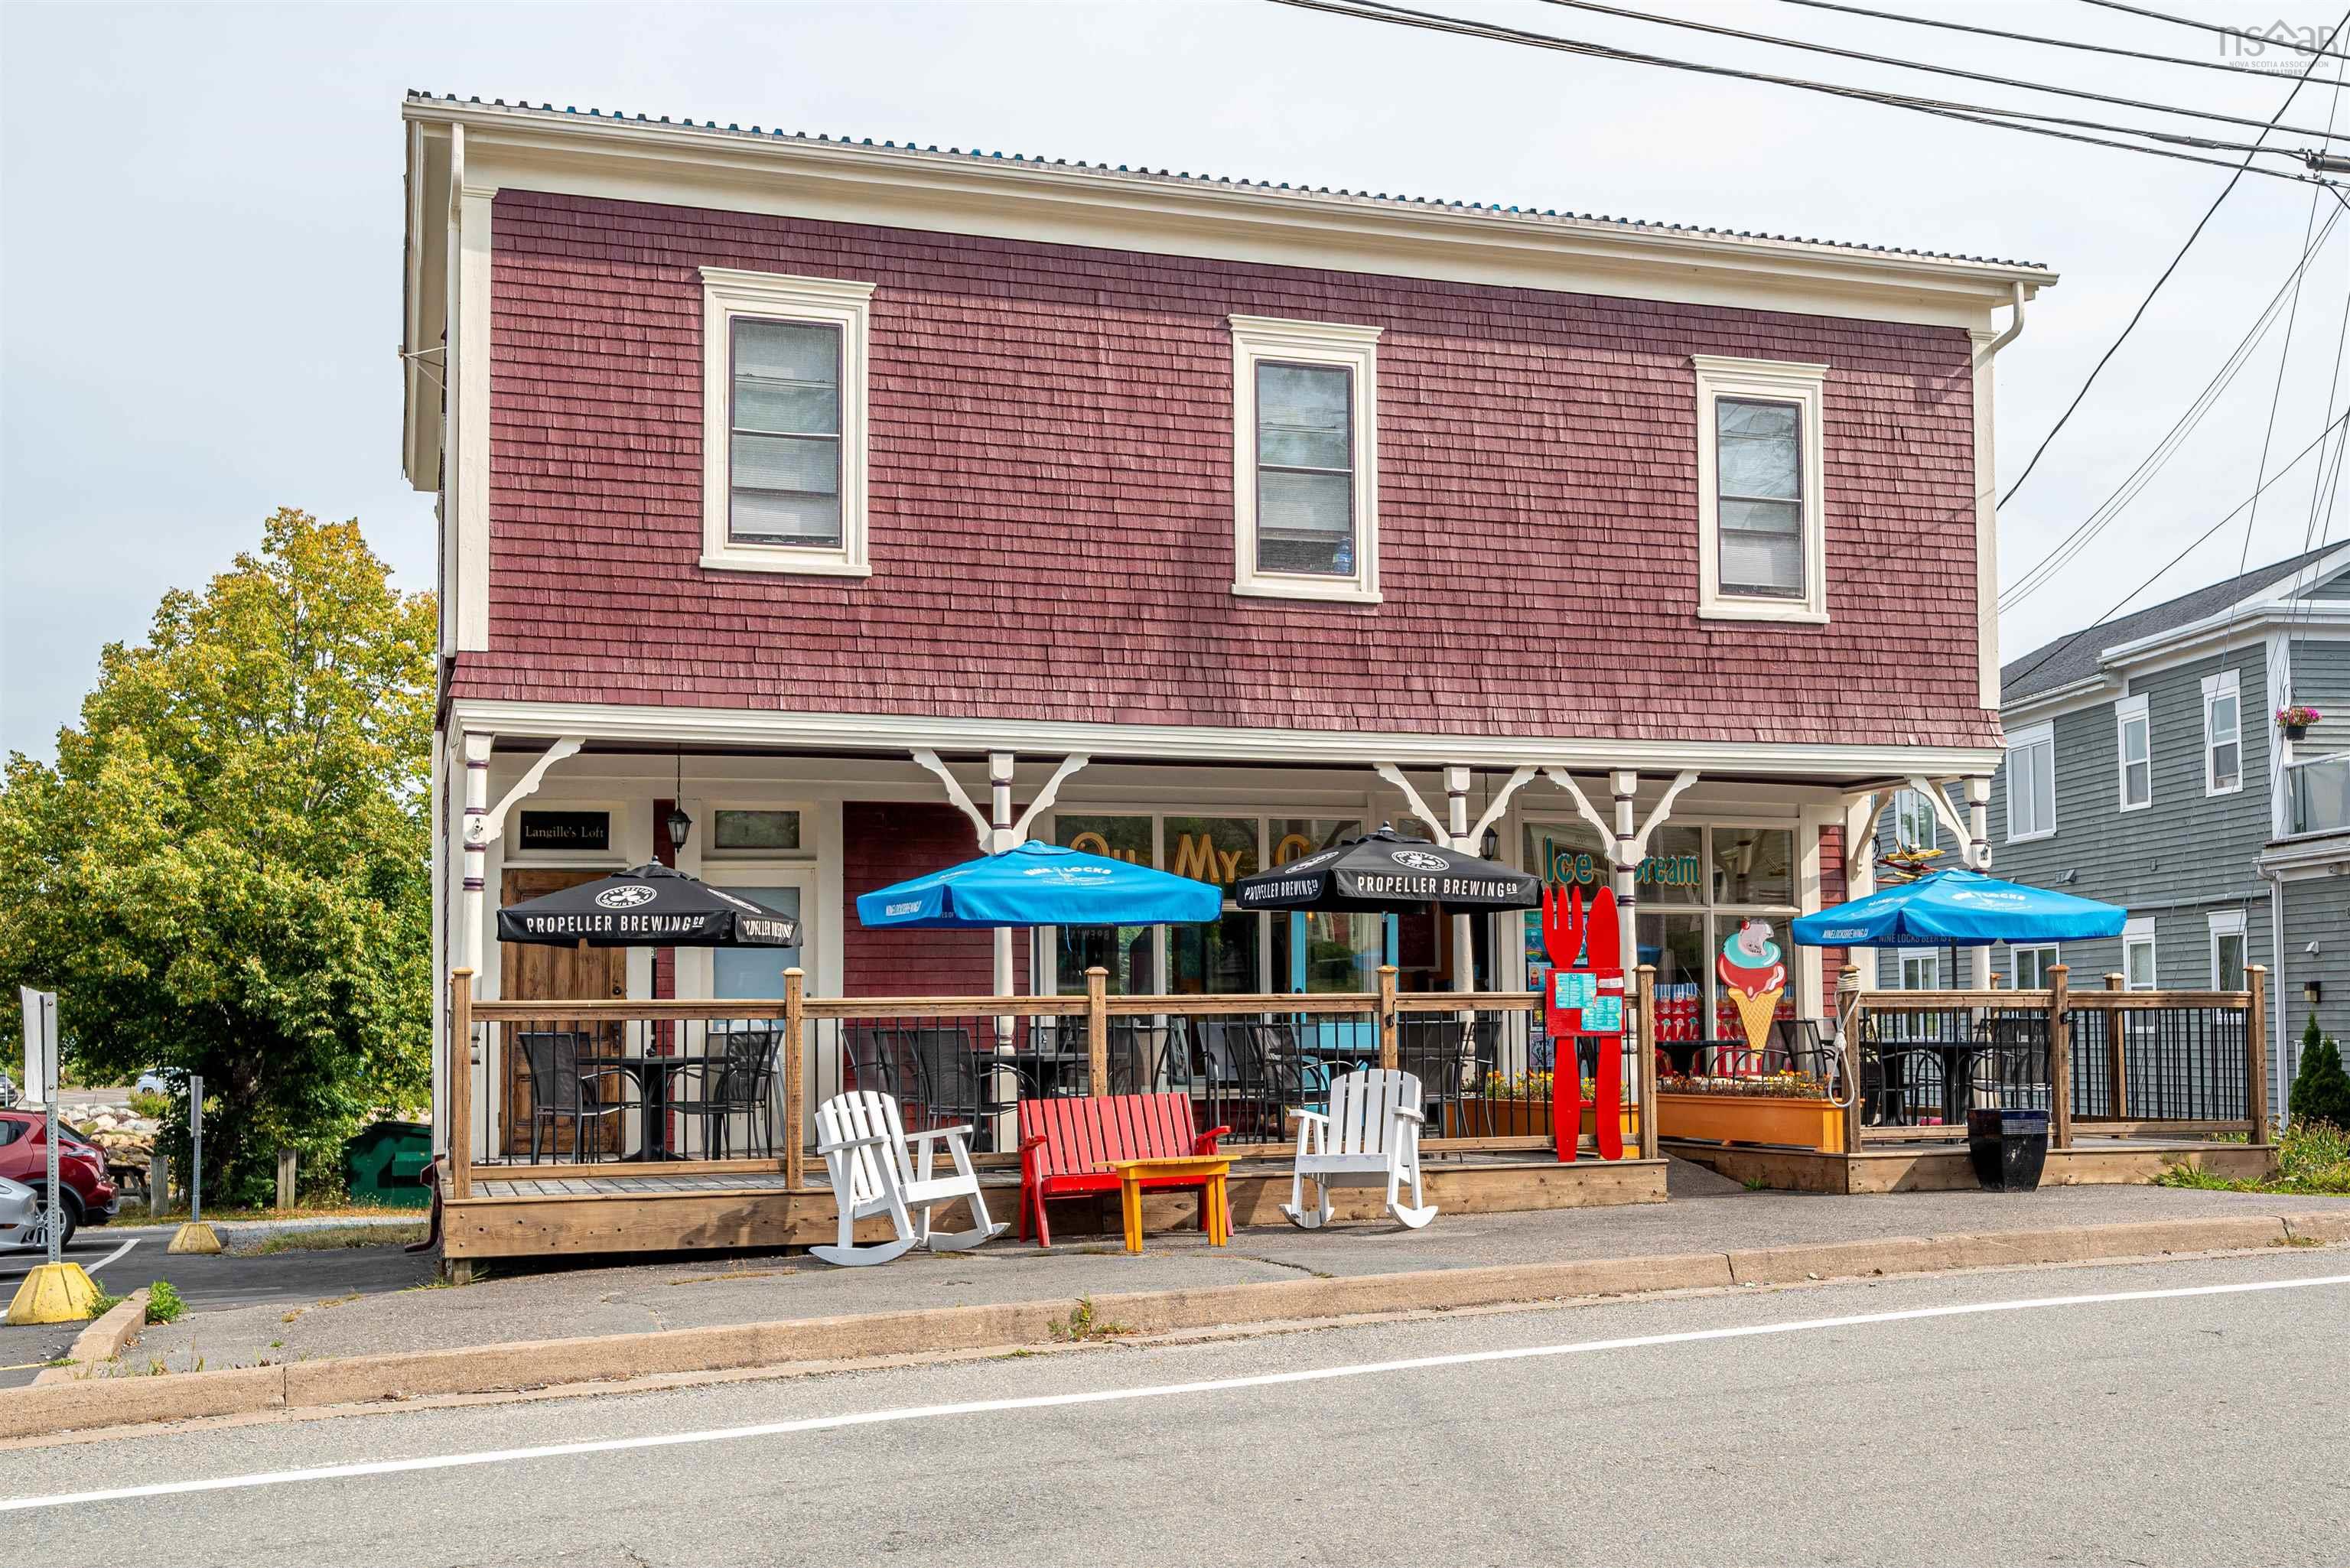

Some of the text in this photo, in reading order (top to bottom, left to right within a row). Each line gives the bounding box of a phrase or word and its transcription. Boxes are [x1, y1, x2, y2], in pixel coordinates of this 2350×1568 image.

[526, 825, 604, 839] Langille's Loft
[1542, 834, 1594, 885] Ice
[1244, 882, 1279, 900] PROPELLER
[1281, 879, 1313, 897] BREWING
[1358, 876, 1437, 893] PROPELLER
[1443, 878, 1505, 898] BREWING
[526, 915, 613, 933] PROPELLER
[620, 915, 691, 932] BREWING
[1879, 933, 1896, 943] NINE
